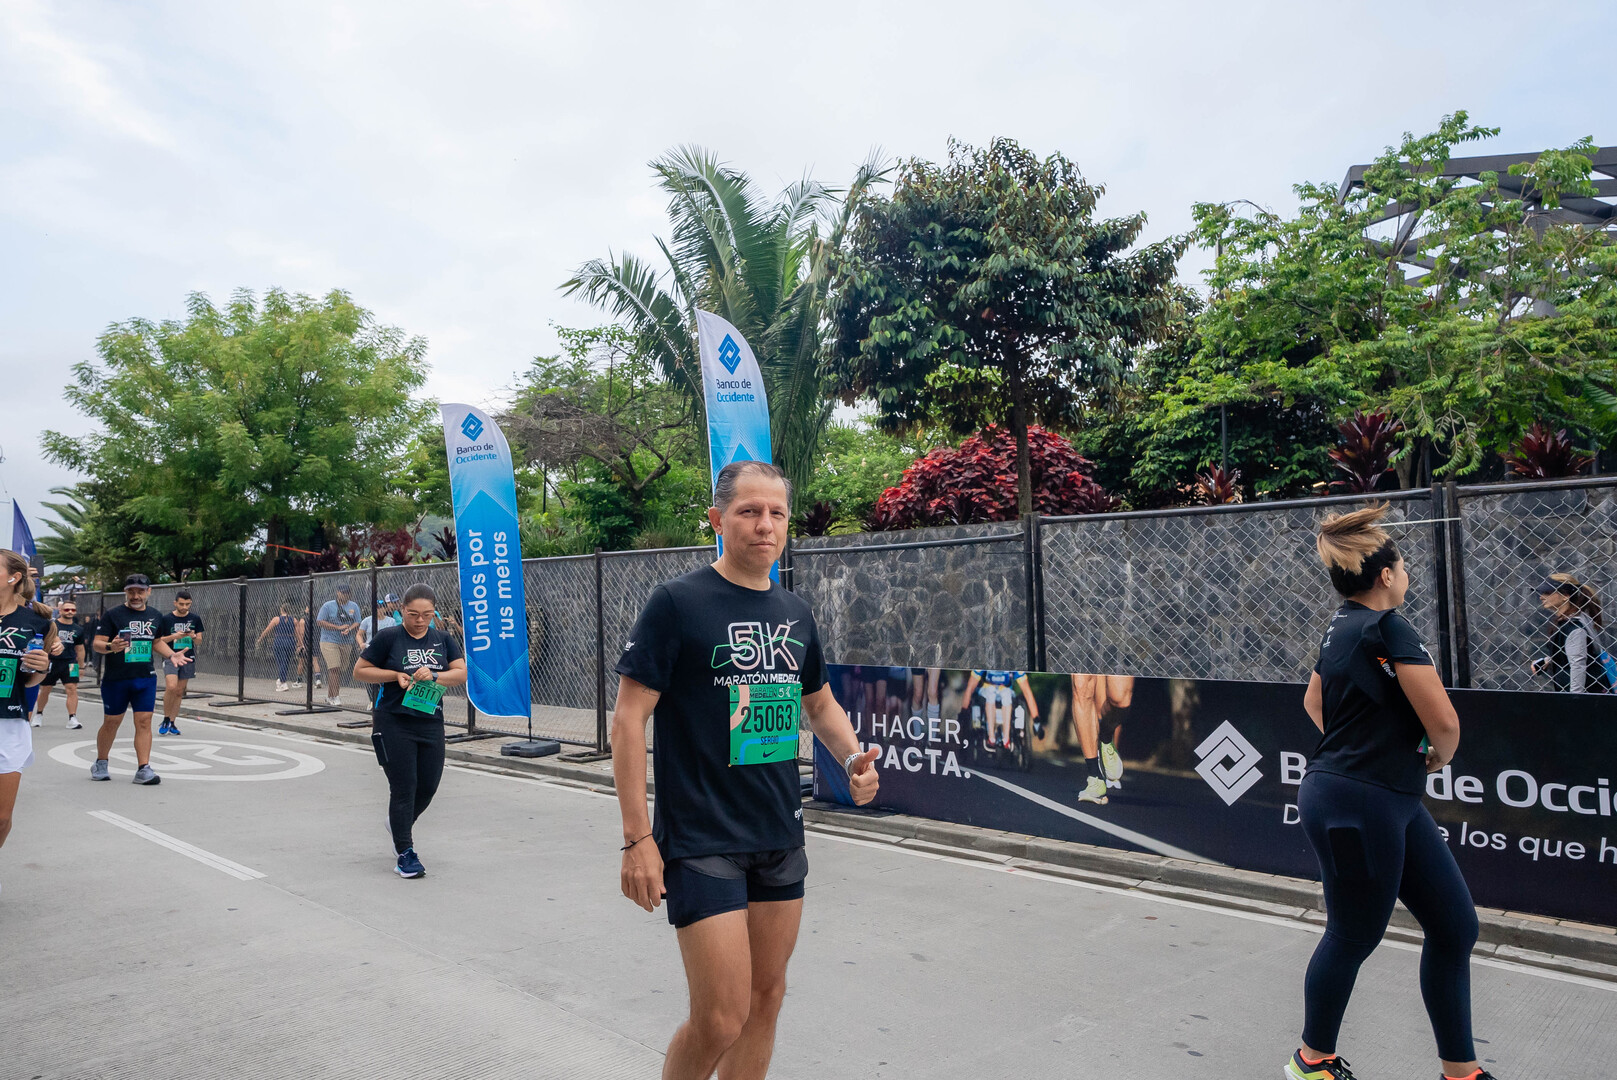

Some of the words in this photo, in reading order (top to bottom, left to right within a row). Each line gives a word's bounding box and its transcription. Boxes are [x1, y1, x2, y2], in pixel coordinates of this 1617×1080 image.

[716, 378, 740, 389] Banco
[741, 378, 752, 389] de
[716, 391, 755, 403] Occidente
[455, 452, 497, 464] Occidente
[456, 444, 479, 456] Banco
[479, 441, 494, 453] de
[468, 529, 490, 565] por
[493, 530, 511, 600] metas
[468, 573, 492, 652] Unidos
[498, 605, 515, 640] tus
[407, 648, 438, 665] 5K
[728, 622, 799, 671] 5K
[409, 683, 436, 701] 25611
[713, 671, 770, 686] MARATÓN
[769, 672, 801, 685] MEDELL
[741, 704, 793, 734] 25063
[872, 713, 969, 749] HACER,
[760, 735, 780, 746] SERGIO
[1426, 764, 1484, 804] de
[1496, 769, 1617, 816] Occi
[1461, 821, 1507, 851] los
[1518, 836, 1586, 861] que
